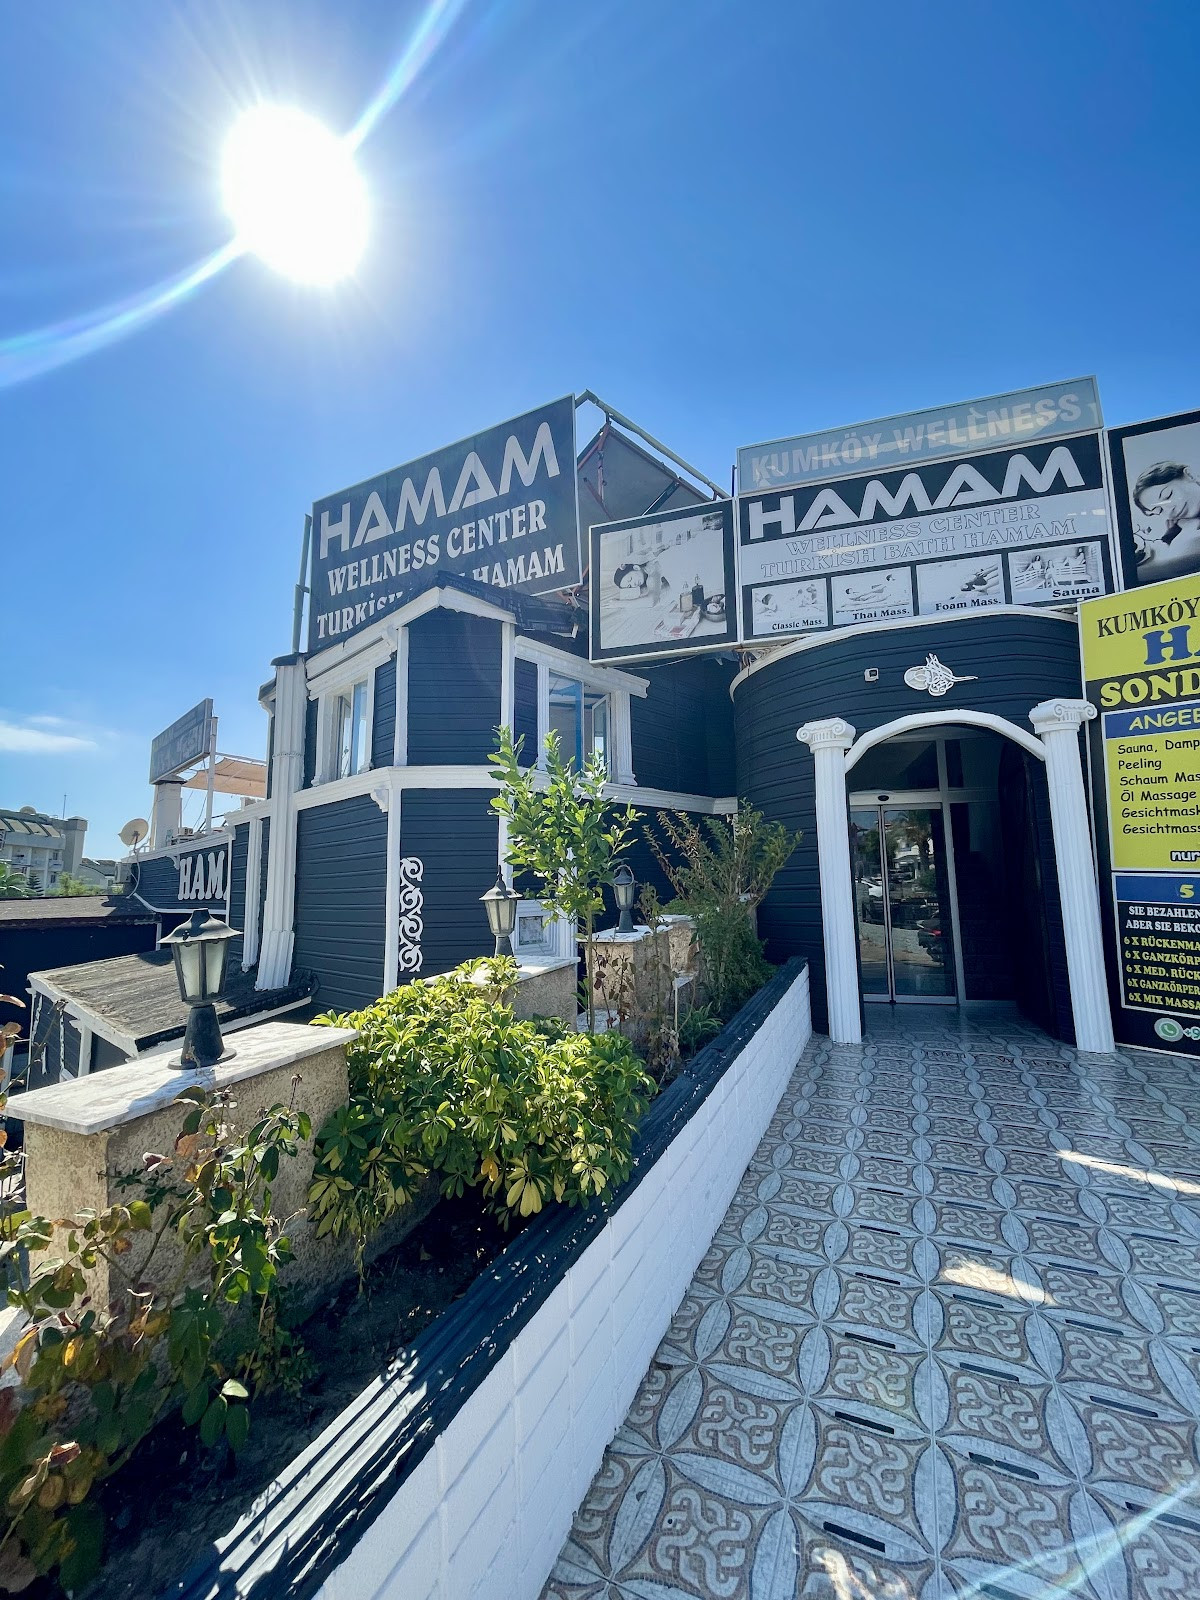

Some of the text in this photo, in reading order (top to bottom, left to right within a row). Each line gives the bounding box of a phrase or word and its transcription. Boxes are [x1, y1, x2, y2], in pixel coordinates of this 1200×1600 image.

[752, 394, 1083, 484] KUMKÖY WELLNESS
[319, 421, 560, 560] HAMAM
[749, 446, 1085, 539] HAMAM
[786, 504, 1040, 556] WELLNESS CENTER
[884, 536, 956, 561] BATH
[964, 518, 1077, 548] HAMAM
[327, 499, 547, 596] WELLNESS CENTER
[472, 543, 566, 588] HAMAM
[1052, 586, 1100, 598] Sauna
[935, 598, 1002, 611] Foam Mass.
[853, 608, 910, 620] Thai Mass.
[1097, 597, 1200, 638] KUMKÖY
[772, 619, 825, 630] Classic Mass.
[1142, 624, 1200, 665] H
[1101, 668, 1200, 707] SOND
[1118, 739, 1200, 755] Sauna, Damp
[1118, 758, 1162, 770] Peeling
[1120, 775, 1168, 787] Schaum
[1121, 789, 1197, 803] Öl Massage
[178, 851, 228, 900] HAM
[1129, 905, 1145, 916] SIE
[1126, 919, 1153, 930] ABER
[1155, 921, 1172, 931] SIE
[1124, 936, 1130, 945] 6
[1131, 936, 1139, 945] X
[1125, 950, 1131, 959] 6
[1132, 950, 1141, 959] X
[1126, 964, 1132, 973] 6
[1134, 964, 1142, 974] X
[1143, 965, 1169, 977] MED.
[1127, 978, 1138, 988] 6X
[1128, 992, 1141, 1002] 6X
[1143, 993, 1164, 1004] MIX
